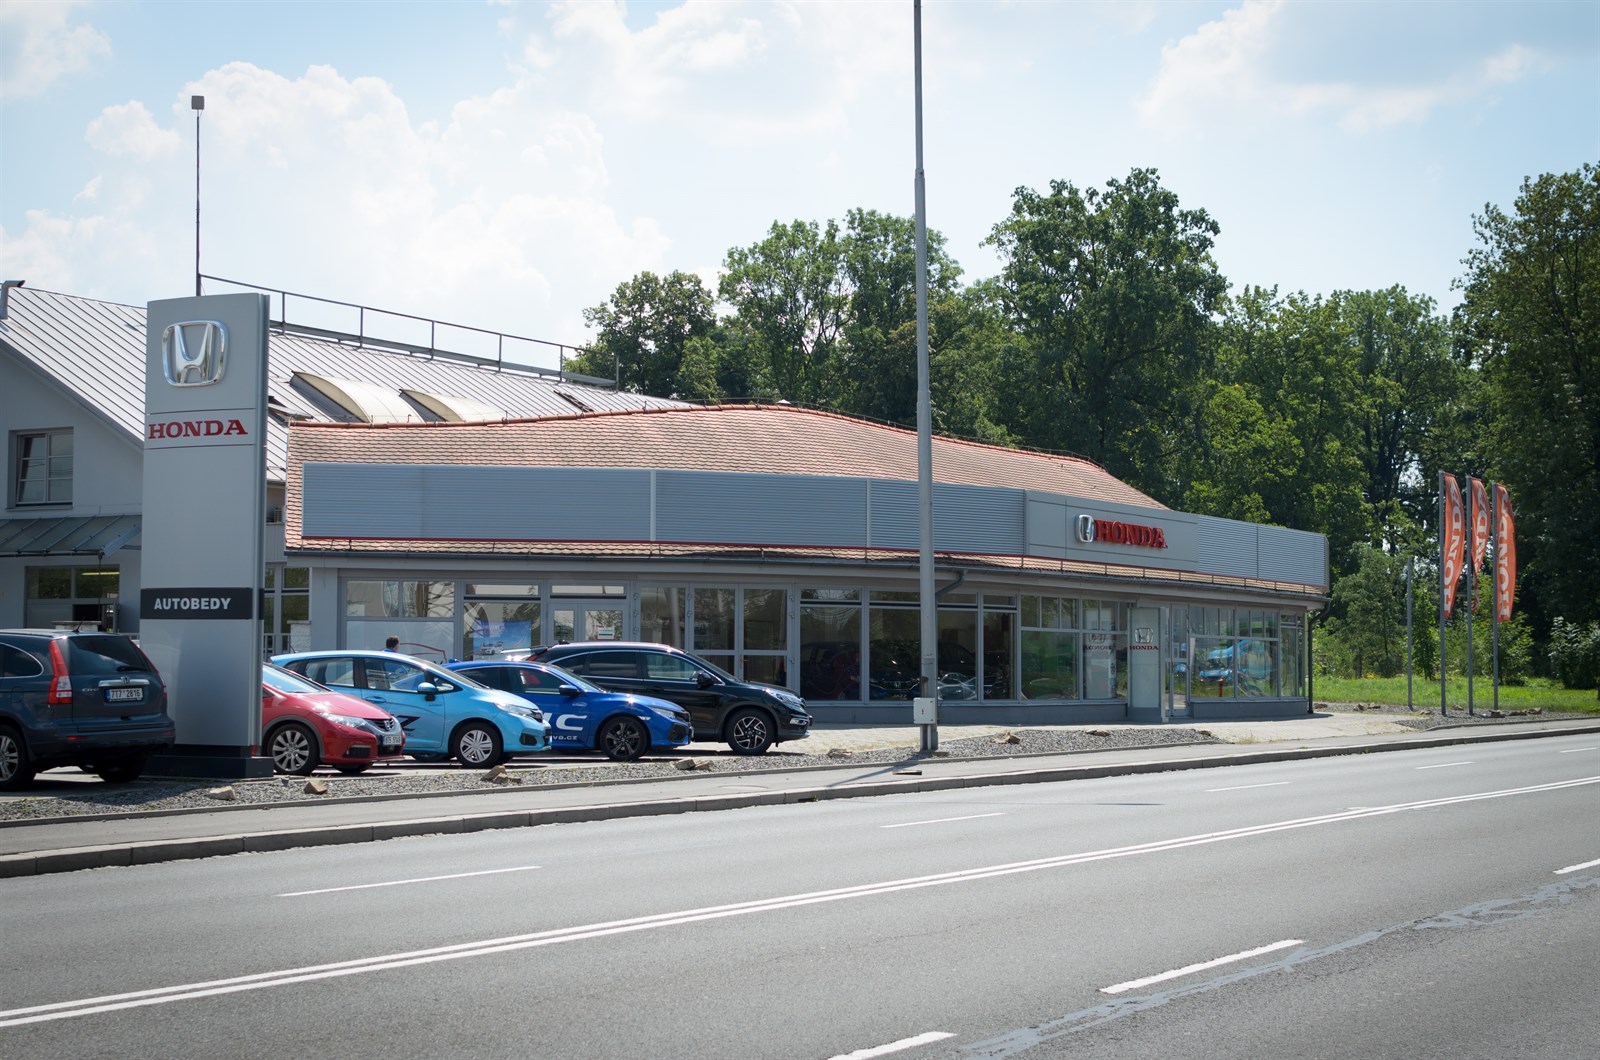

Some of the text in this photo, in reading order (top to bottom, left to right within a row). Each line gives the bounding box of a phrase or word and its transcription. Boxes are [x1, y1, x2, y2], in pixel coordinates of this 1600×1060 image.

[148, 419, 248, 439] HONDA
[1094, 520, 1168, 548] HONDA
[1443, 482, 1462, 613] HONDA
[154, 597, 231, 610] AUTOBEDY
[111, 689, 141, 698] 7T7 2816
